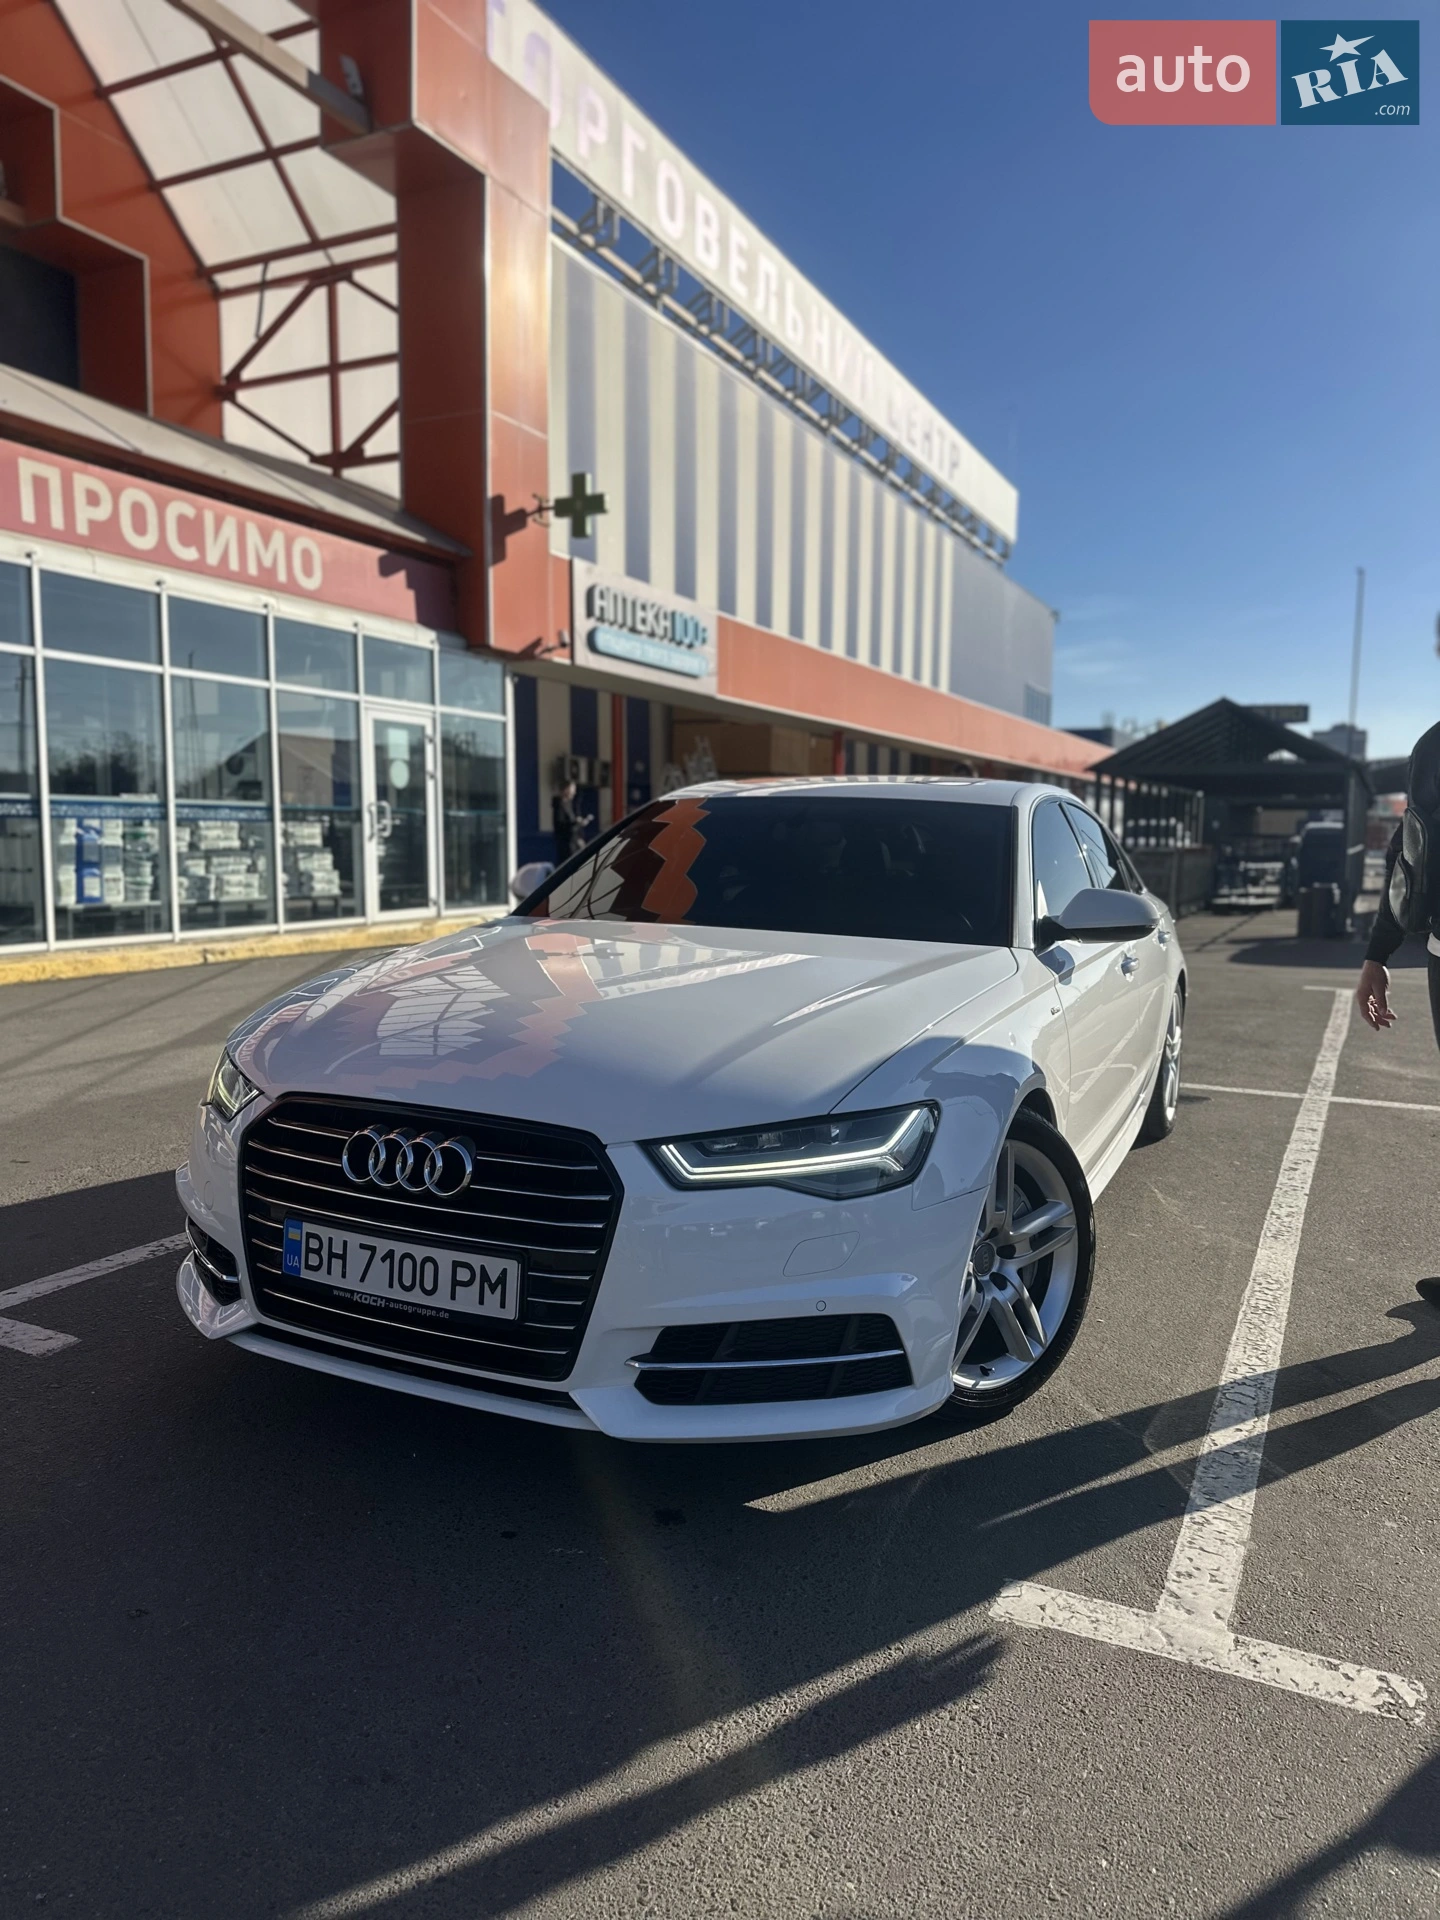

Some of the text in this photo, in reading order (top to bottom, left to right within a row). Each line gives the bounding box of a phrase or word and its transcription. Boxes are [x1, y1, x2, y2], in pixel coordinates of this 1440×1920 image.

[17, 456, 323, 591] ПРОСИМО
[286, 1253, 300, 1268] UA
[304, 1231, 508, 1310] BH 7100 PM
